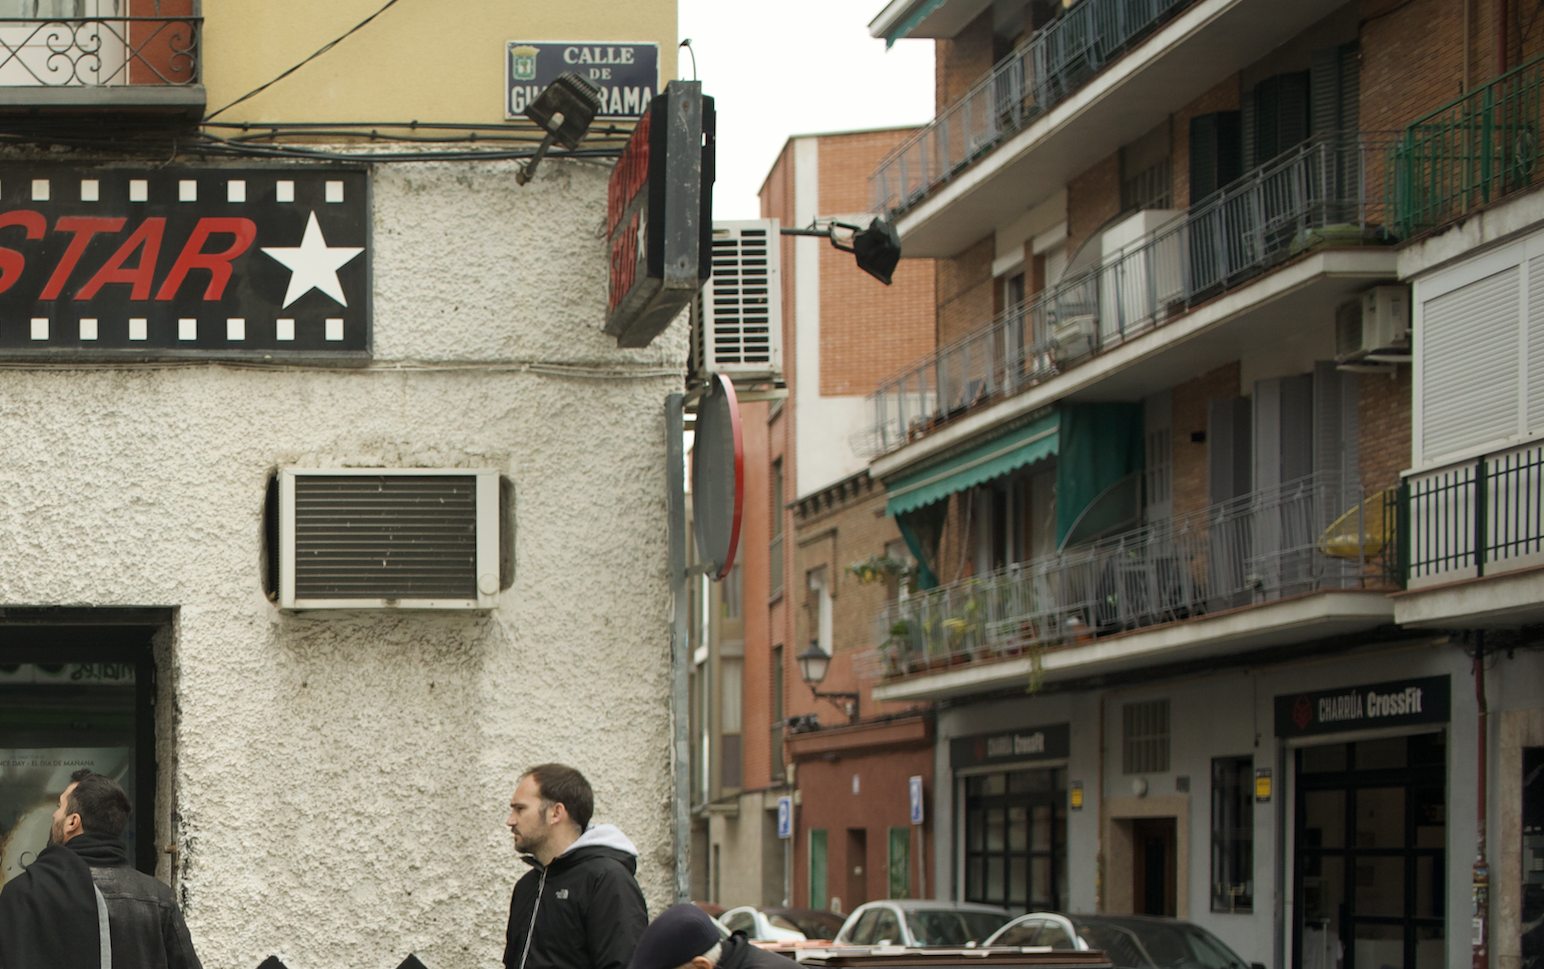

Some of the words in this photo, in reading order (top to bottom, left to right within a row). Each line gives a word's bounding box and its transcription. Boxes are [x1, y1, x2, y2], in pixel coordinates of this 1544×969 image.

[563, 46, 635, 65] CALLE
[589, 68, 612, 80] DE
[511, 86, 652, 114] GURAMA
[1318, 689, 1364, 723] CHARRÚA
[1367, 686, 1423, 718] CrossFit
[40, 759, 52, 767] DÍA
[63, 758, 95, 767] MAÑANA
